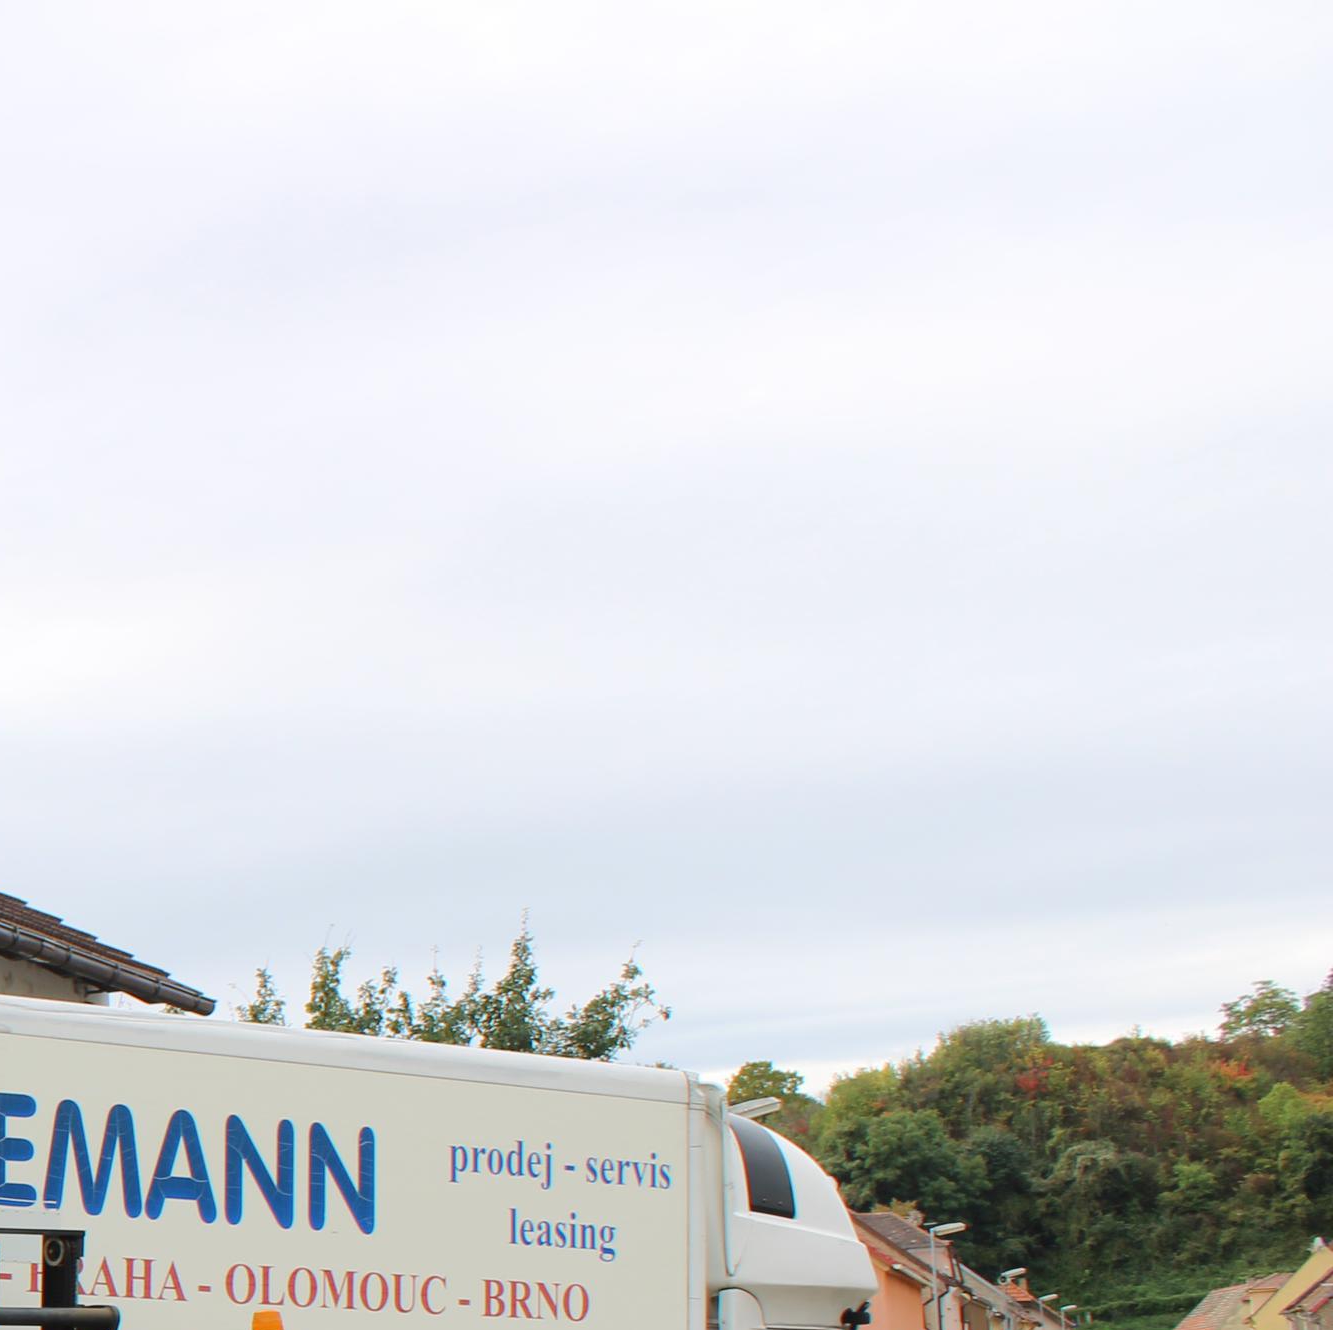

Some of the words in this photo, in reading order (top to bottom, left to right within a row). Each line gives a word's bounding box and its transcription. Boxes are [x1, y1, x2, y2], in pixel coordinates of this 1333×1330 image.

[449, 1139, 552, 1191] prodej
[564, 1164, 576, 1172] -
[585, 1151, 672, 1190] servis
[507, 1207, 617, 1263] leasing
[198, 1284, 212, 1292] -
[224, 1263, 448, 1315] OLOMOUC
[457, 1298, 471, 1306] -
[480, 1278, 590, 1323] BRNO
